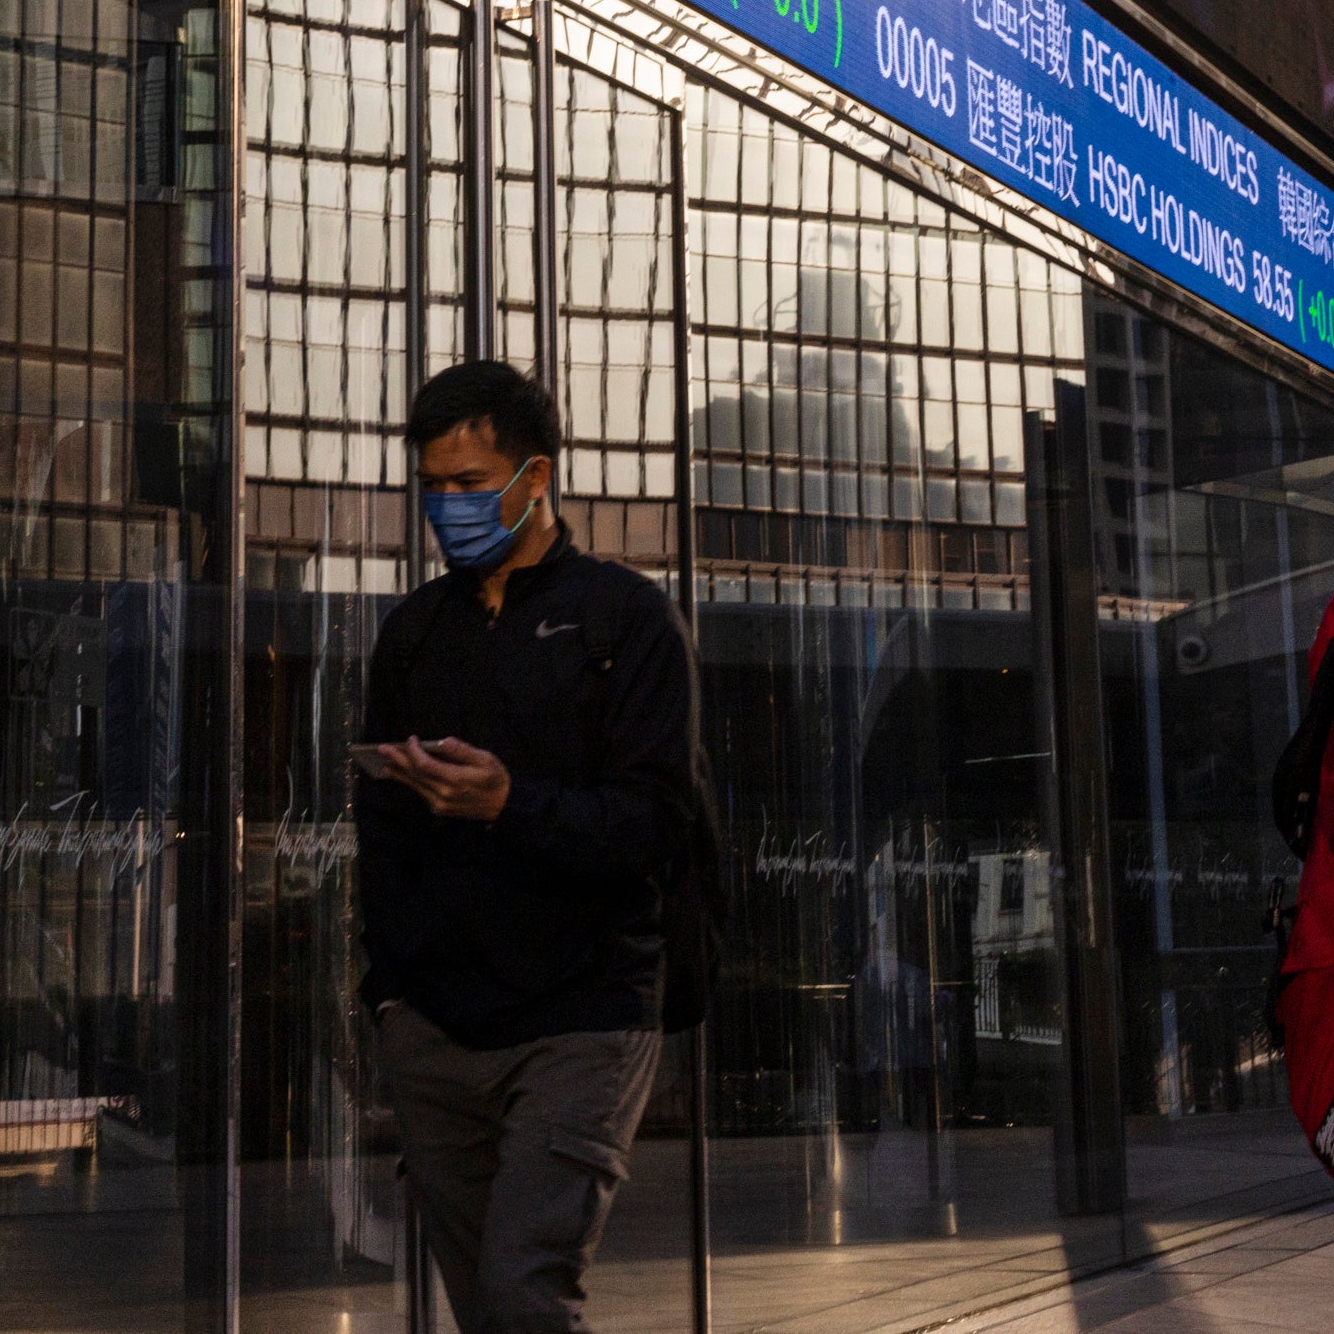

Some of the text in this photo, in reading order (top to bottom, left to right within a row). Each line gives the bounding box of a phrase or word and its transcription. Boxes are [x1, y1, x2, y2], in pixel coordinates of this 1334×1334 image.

[875, 5, 957, 118] 00005
[1081, 28, 1260, 206] REGIONAL INDICES
[1087, 144, 1148, 234] HSBC
[1150, 184, 1247, 294] HOLDINGS
[1252, 249, 1295, 324] 58.55
